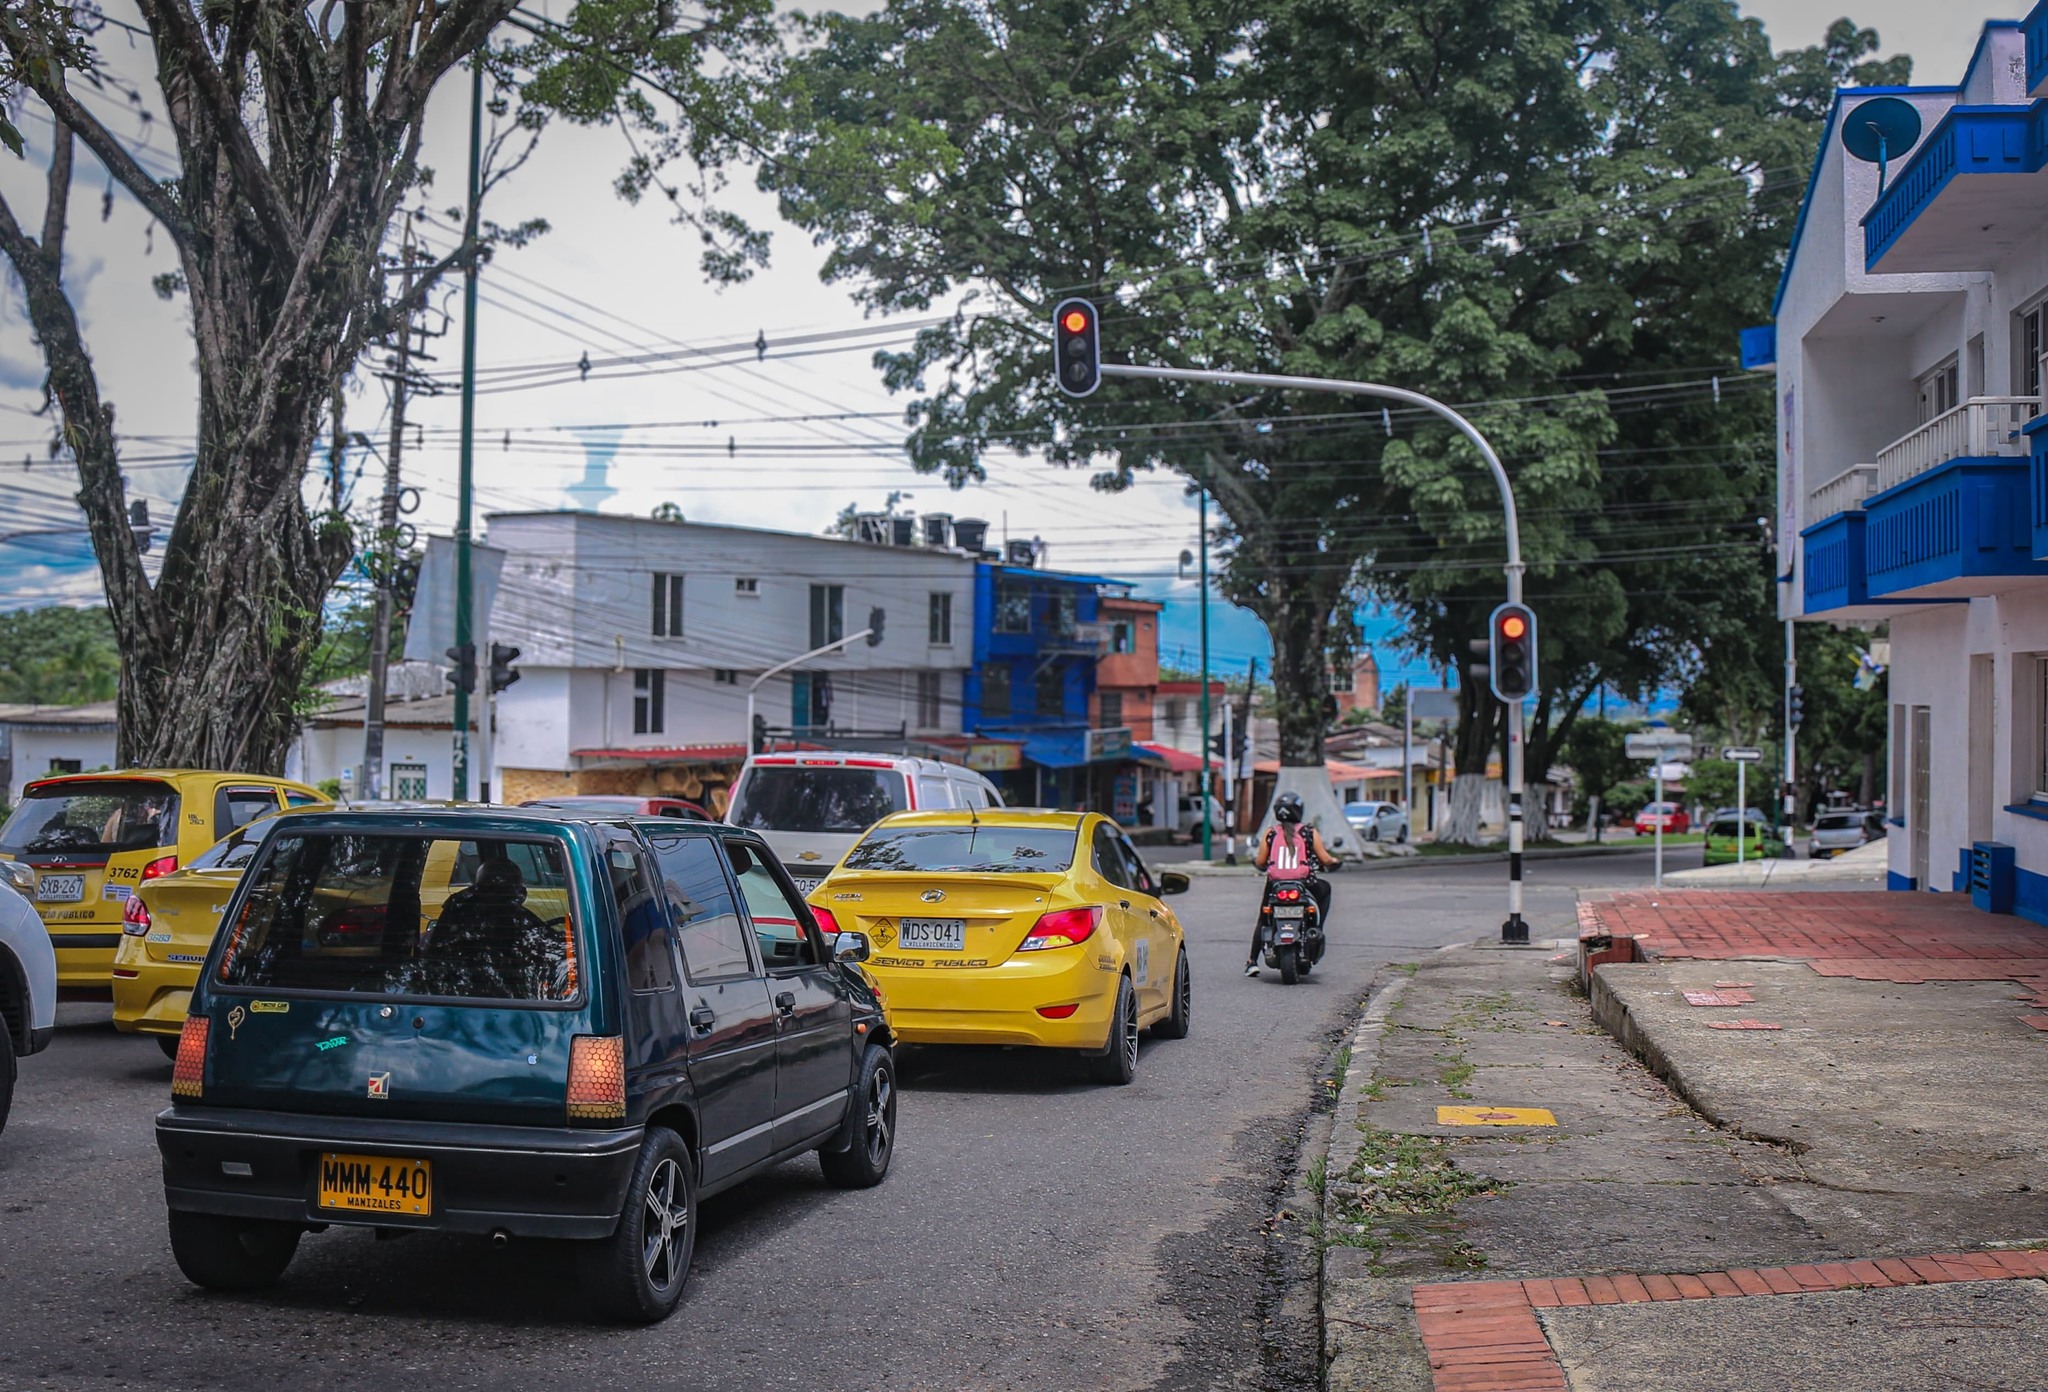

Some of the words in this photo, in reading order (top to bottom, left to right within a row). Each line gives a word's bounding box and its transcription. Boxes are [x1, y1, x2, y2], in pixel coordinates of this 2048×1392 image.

[109, 867, 139, 879] 3762
[908, 941, 955, 949] VILLAVICENCIO
[347, 1196, 402, 1210] MANIZALES
